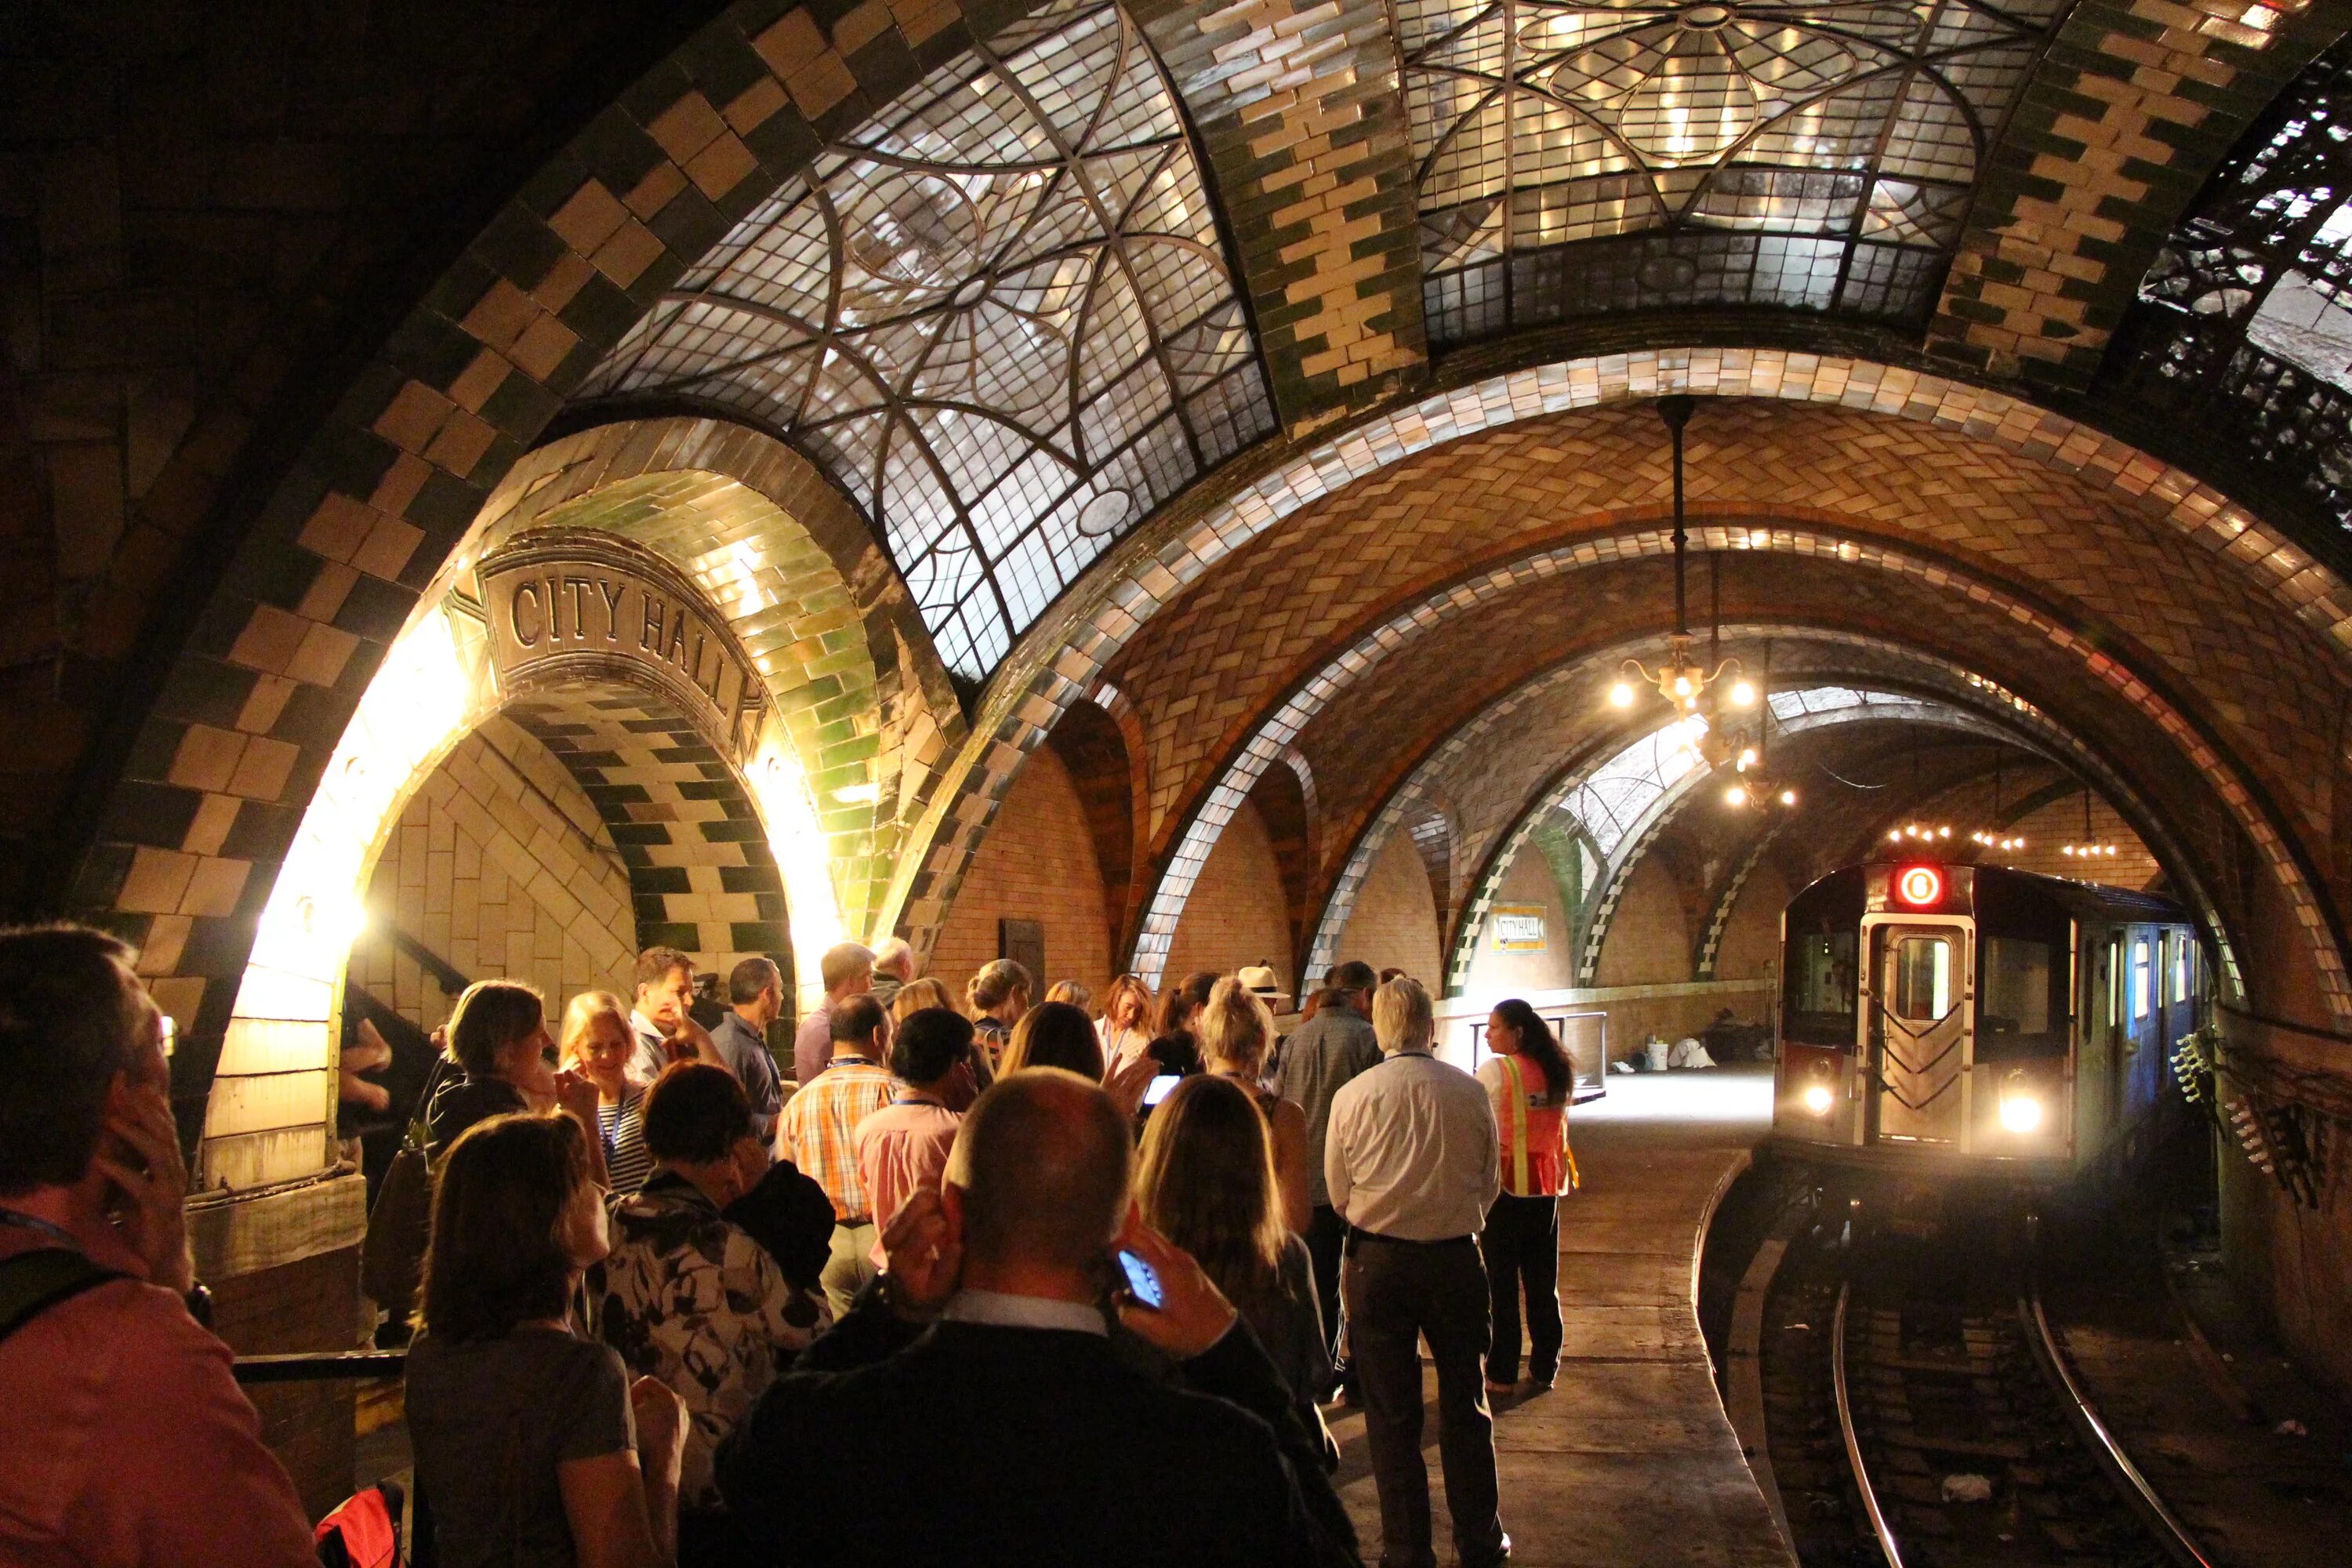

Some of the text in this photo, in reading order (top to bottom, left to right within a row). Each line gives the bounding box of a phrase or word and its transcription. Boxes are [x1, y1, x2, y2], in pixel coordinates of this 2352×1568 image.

[510, 575, 728, 720] CITY HALL
[1501, 919, 1537, 936] CITY HALL
